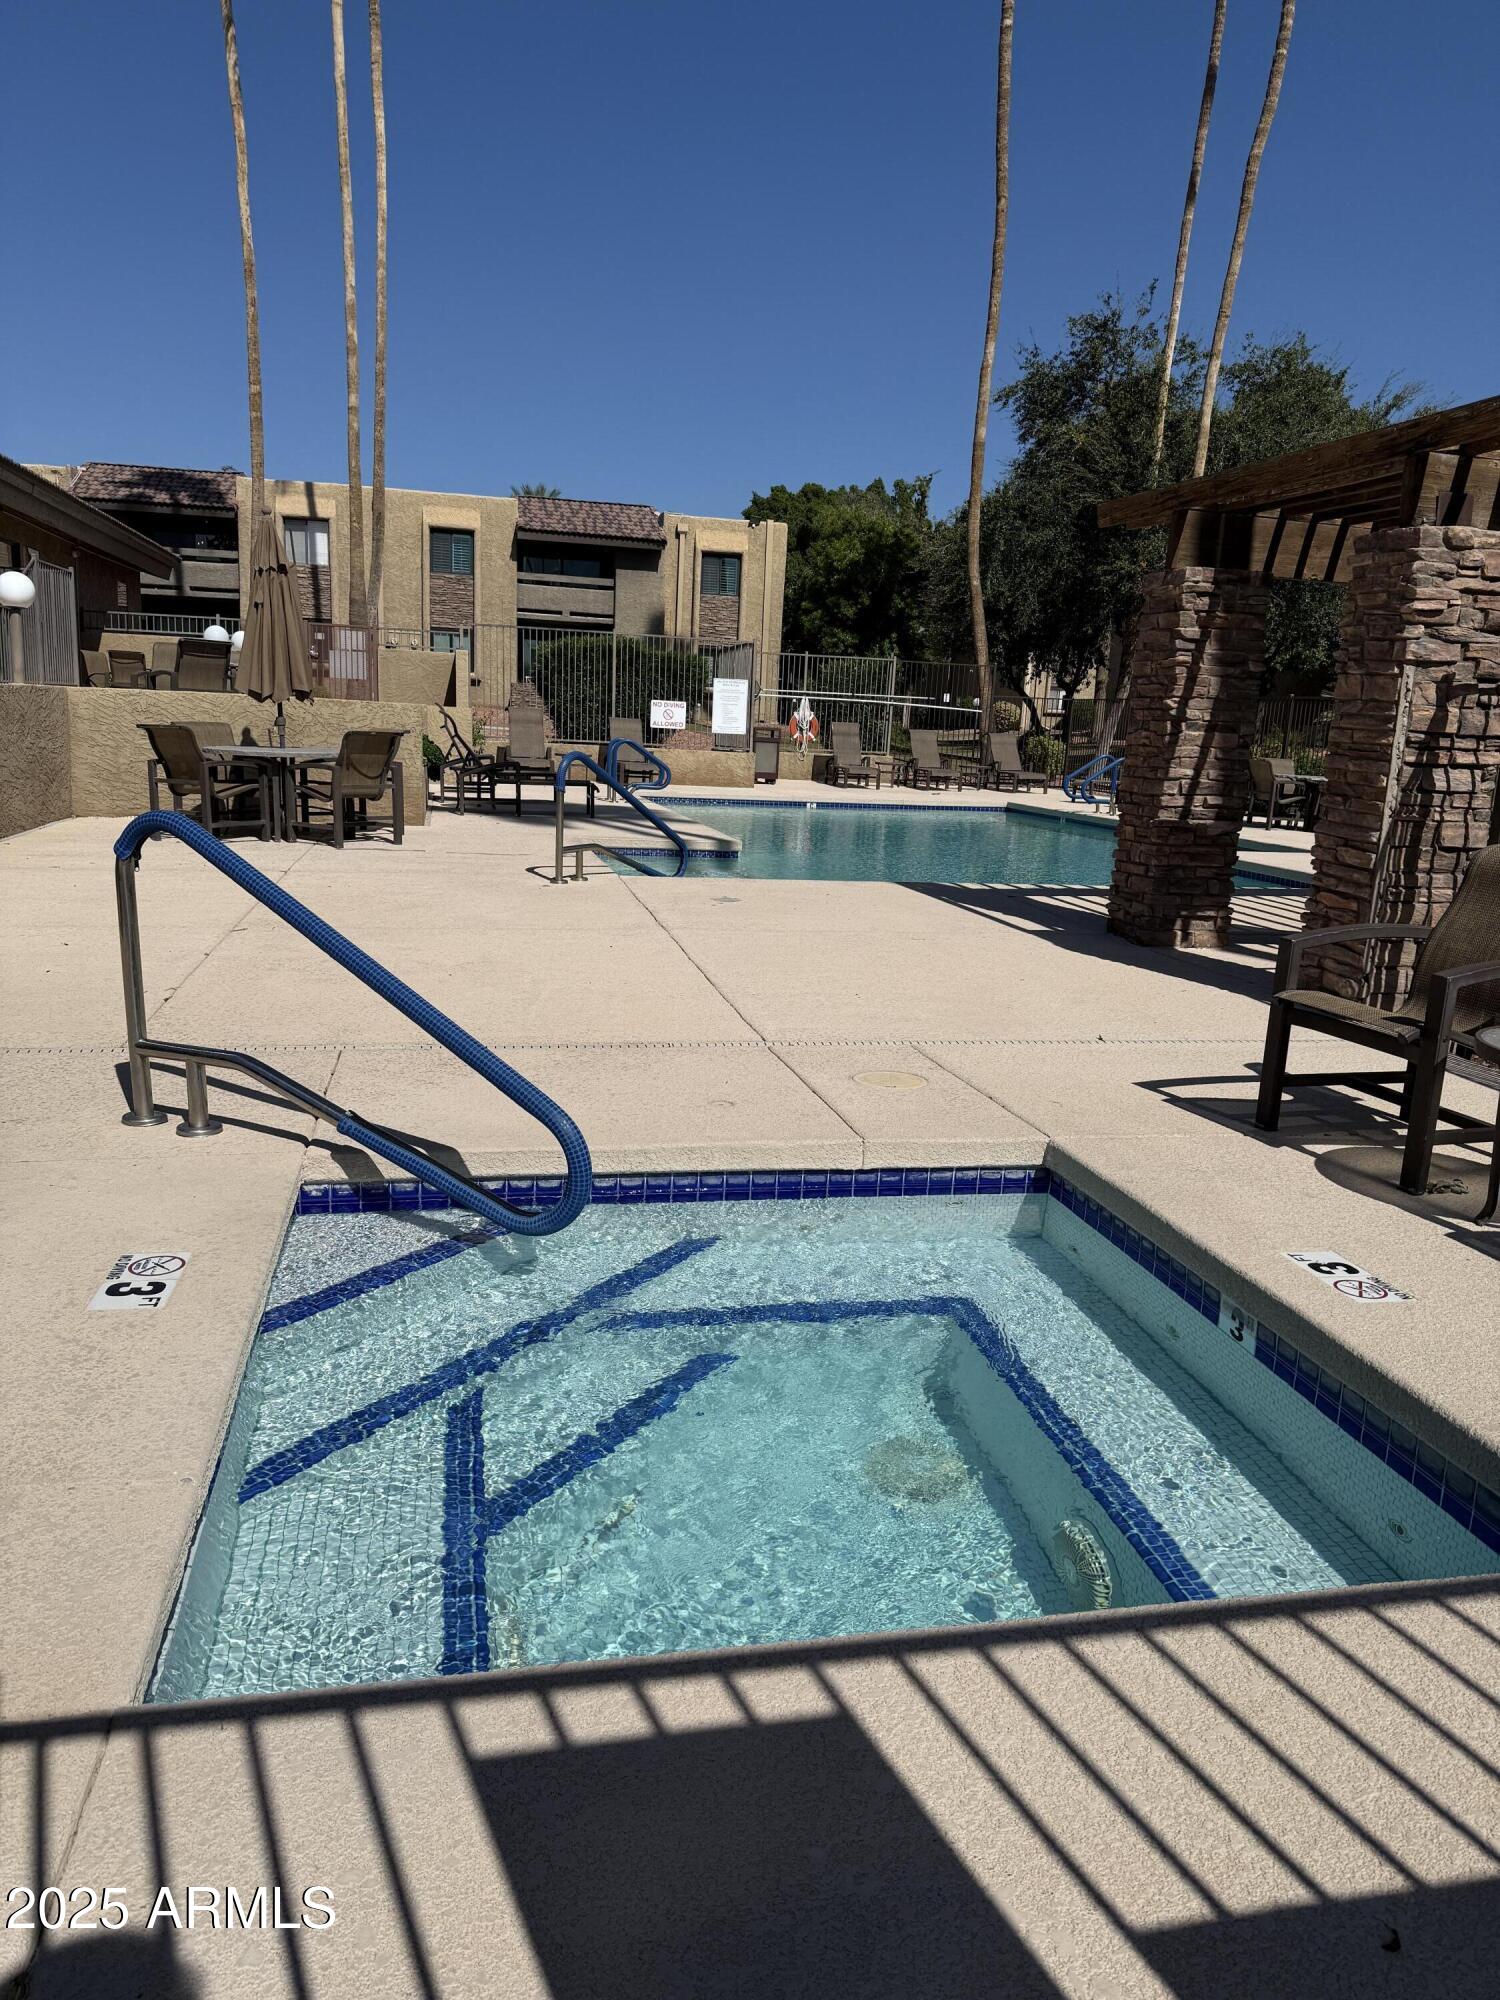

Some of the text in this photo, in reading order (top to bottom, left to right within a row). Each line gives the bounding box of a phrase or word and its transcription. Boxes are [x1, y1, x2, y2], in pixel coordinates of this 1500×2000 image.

[1287, 1253, 1360, 1275] 3 FT
[105, 1281, 167, 1307] 3 FT
[1230, 1308, 1244, 1342] 3
